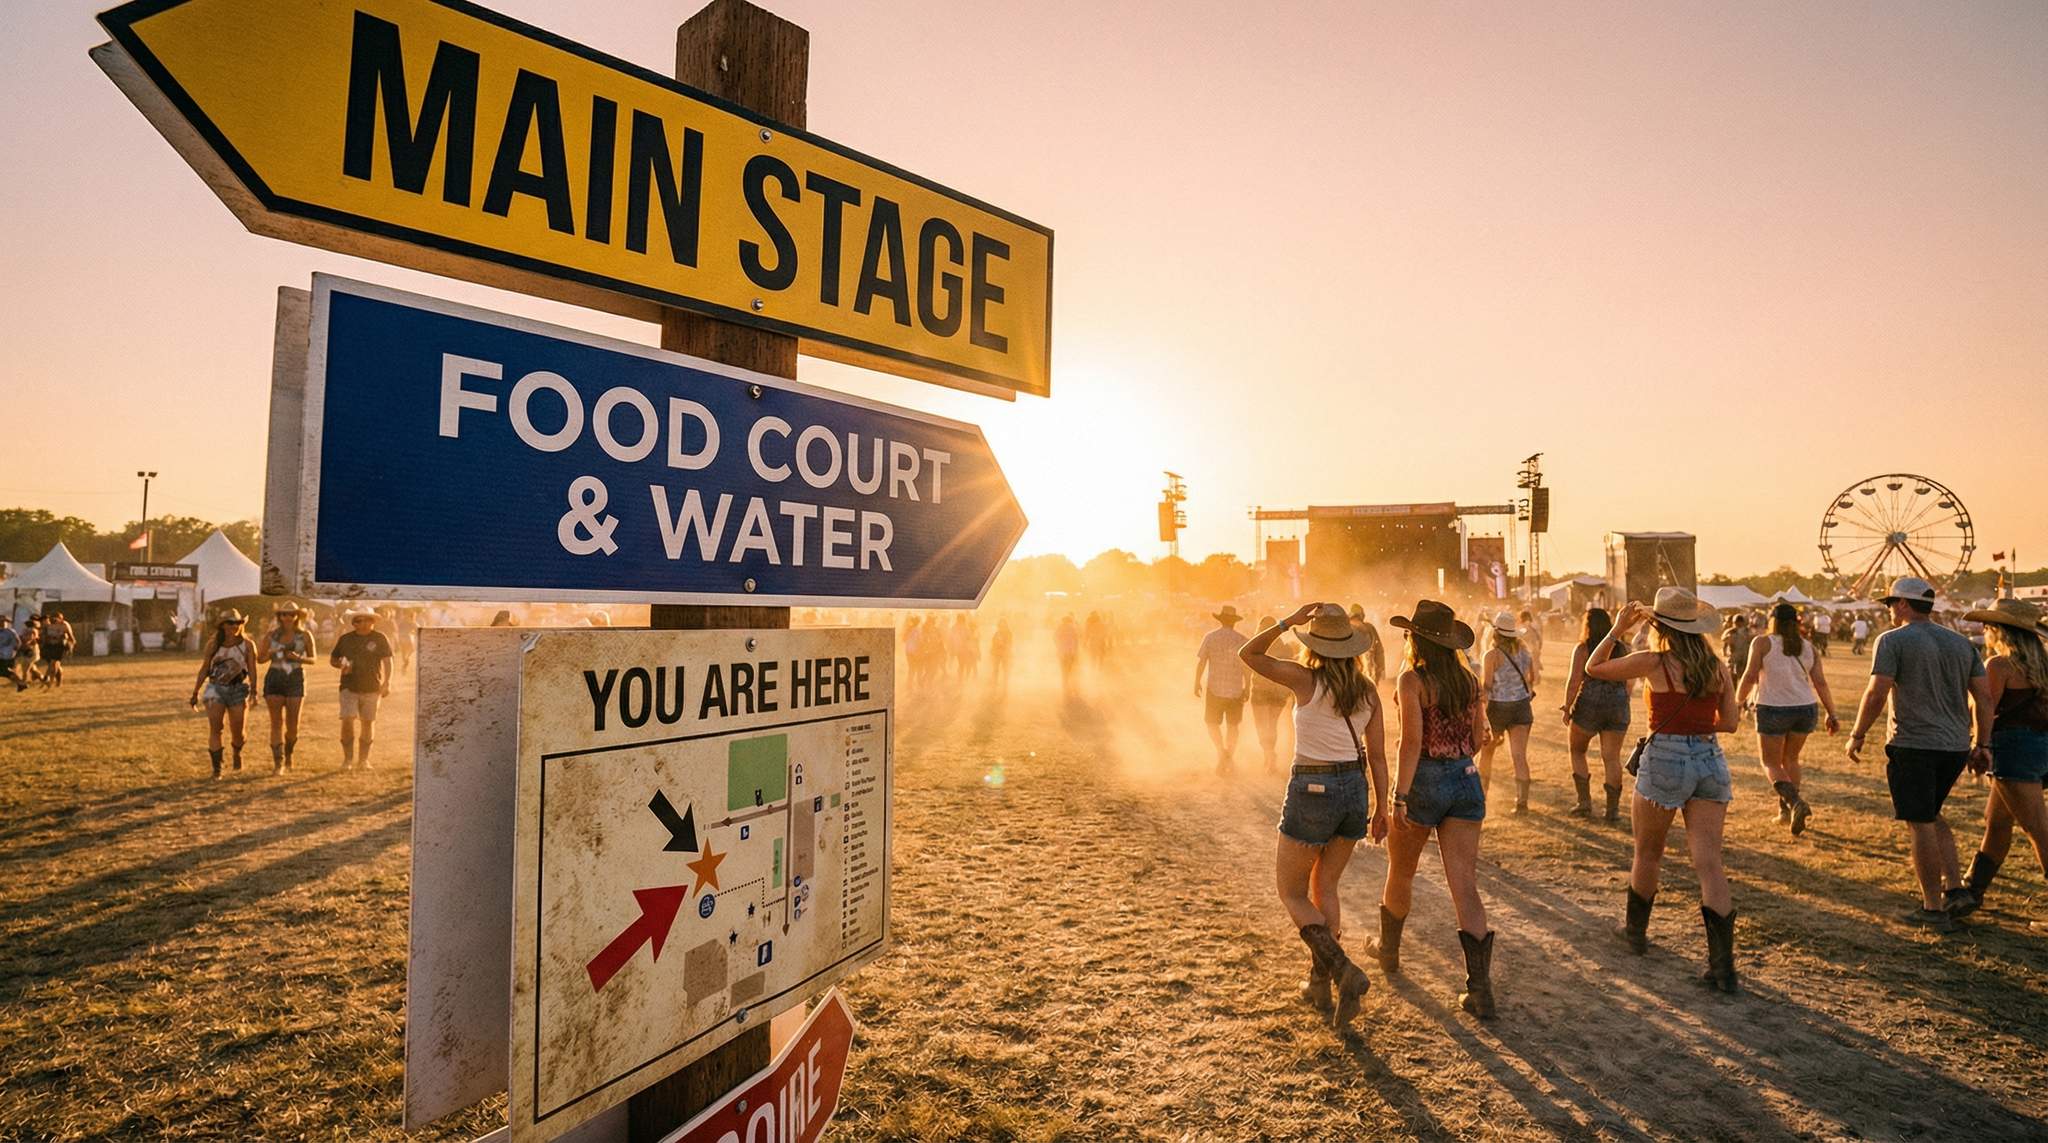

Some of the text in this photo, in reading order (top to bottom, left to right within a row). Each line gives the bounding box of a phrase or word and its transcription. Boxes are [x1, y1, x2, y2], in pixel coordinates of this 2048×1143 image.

[343, 10, 1010, 353] MAIN STAGE
[439, 353, 952, 505] FOOD COURT
[557, 476, 894, 572] & WATER
[583, 656, 870, 731] YOU ARE HERE
